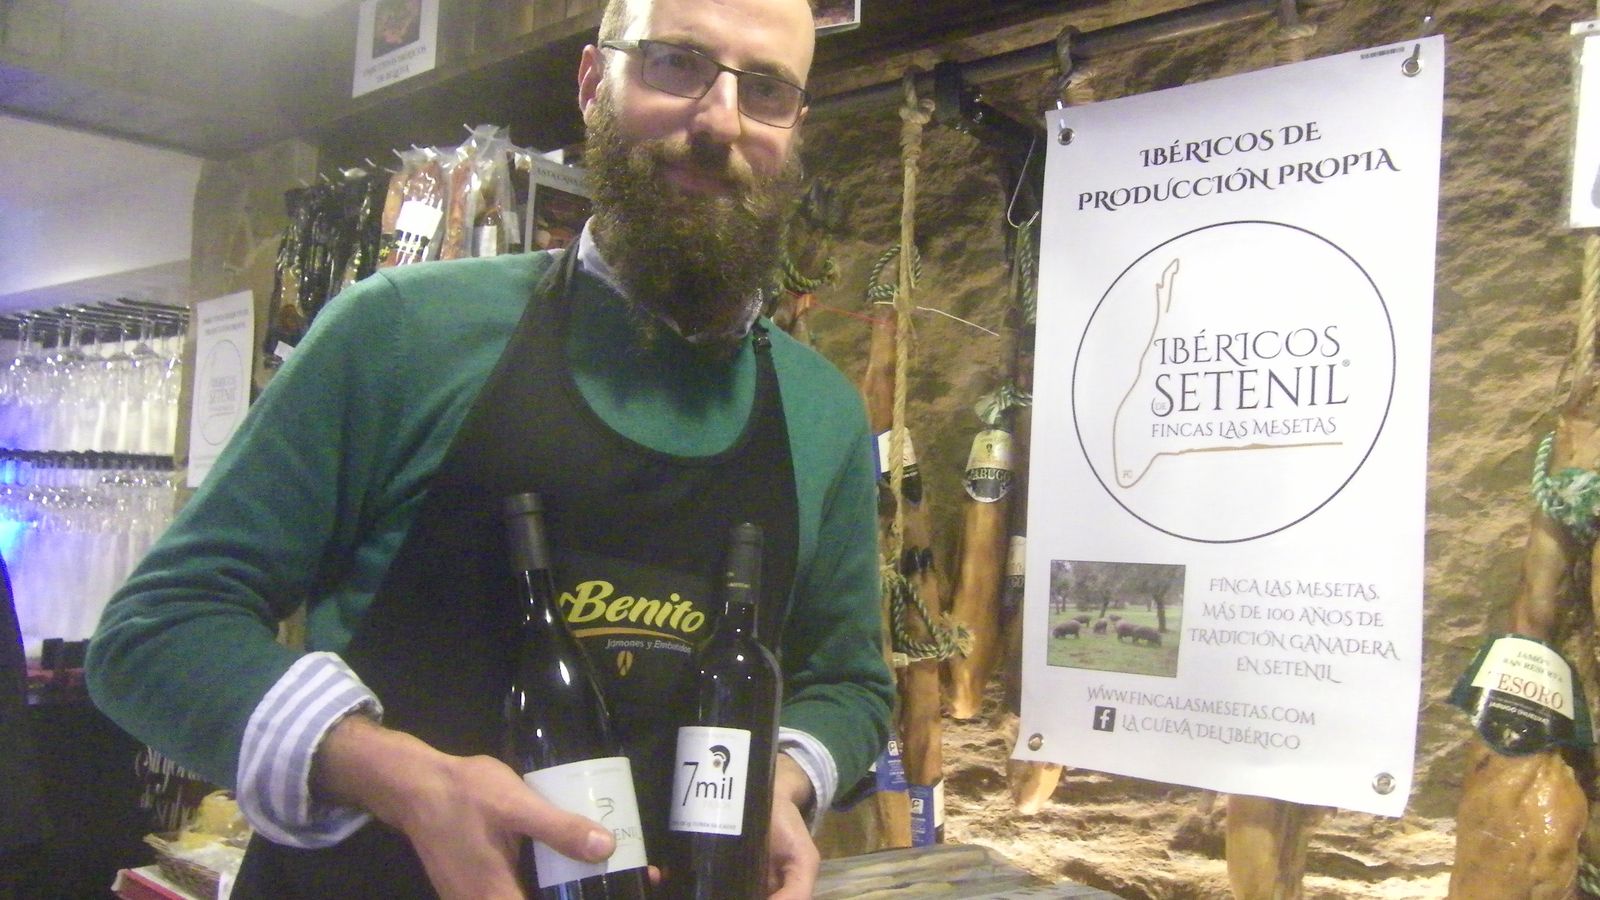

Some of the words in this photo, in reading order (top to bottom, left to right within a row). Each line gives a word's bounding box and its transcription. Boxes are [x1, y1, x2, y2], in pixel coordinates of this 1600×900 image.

[1139, 129, 1274, 167] IBÉRICOS
[1279, 121, 1321, 146] DE
[1078, 167, 1276, 211] PRODUCCIÓN
[1278, 148, 1400, 185] PROPIA
[1154, 325, 1341, 367] IBÉRICOS
[1151, 364, 1350, 417] SETENIL
[1151, 422, 1214, 438] FINCAS
[1219, 421, 1249, 439] LAS
[1253, 416, 1337, 438] MESETAS
[1209, 576, 1261, 595] FINCA
[1264, 579, 1292, 597] LAS
[560, 580, 705, 632] Benito
[1201, 601, 1236, 621] MÁS
[1240, 605, 1262, 620] DE
[1267, 607, 1295, 621] 100
[1299, 606, 1353, 627] AÑOS
[1357, 611, 1384, 627] DE
[605, 638, 645, 650] Jamones
[646, 640, 653, 650] y
[1188, 627, 1288, 650] TRADICIÓN
[1290, 632, 1400, 660] GANADERA
[1236, 656, 1263, 675] EN
[1264, 659, 1343, 684] SETENIL
[1087, 684, 1316, 726] WWW.FINCALASMESETAS.COM
[1493, 672, 1563, 710] ESORO
[1122, 714, 1139, 733] LA
[1141, 716, 1194, 740] CUEVA
[1194, 723, 1230, 744] DEL
[1228, 726, 1301, 750] IBÉRICO
[682, 761, 733, 807] 7mil
